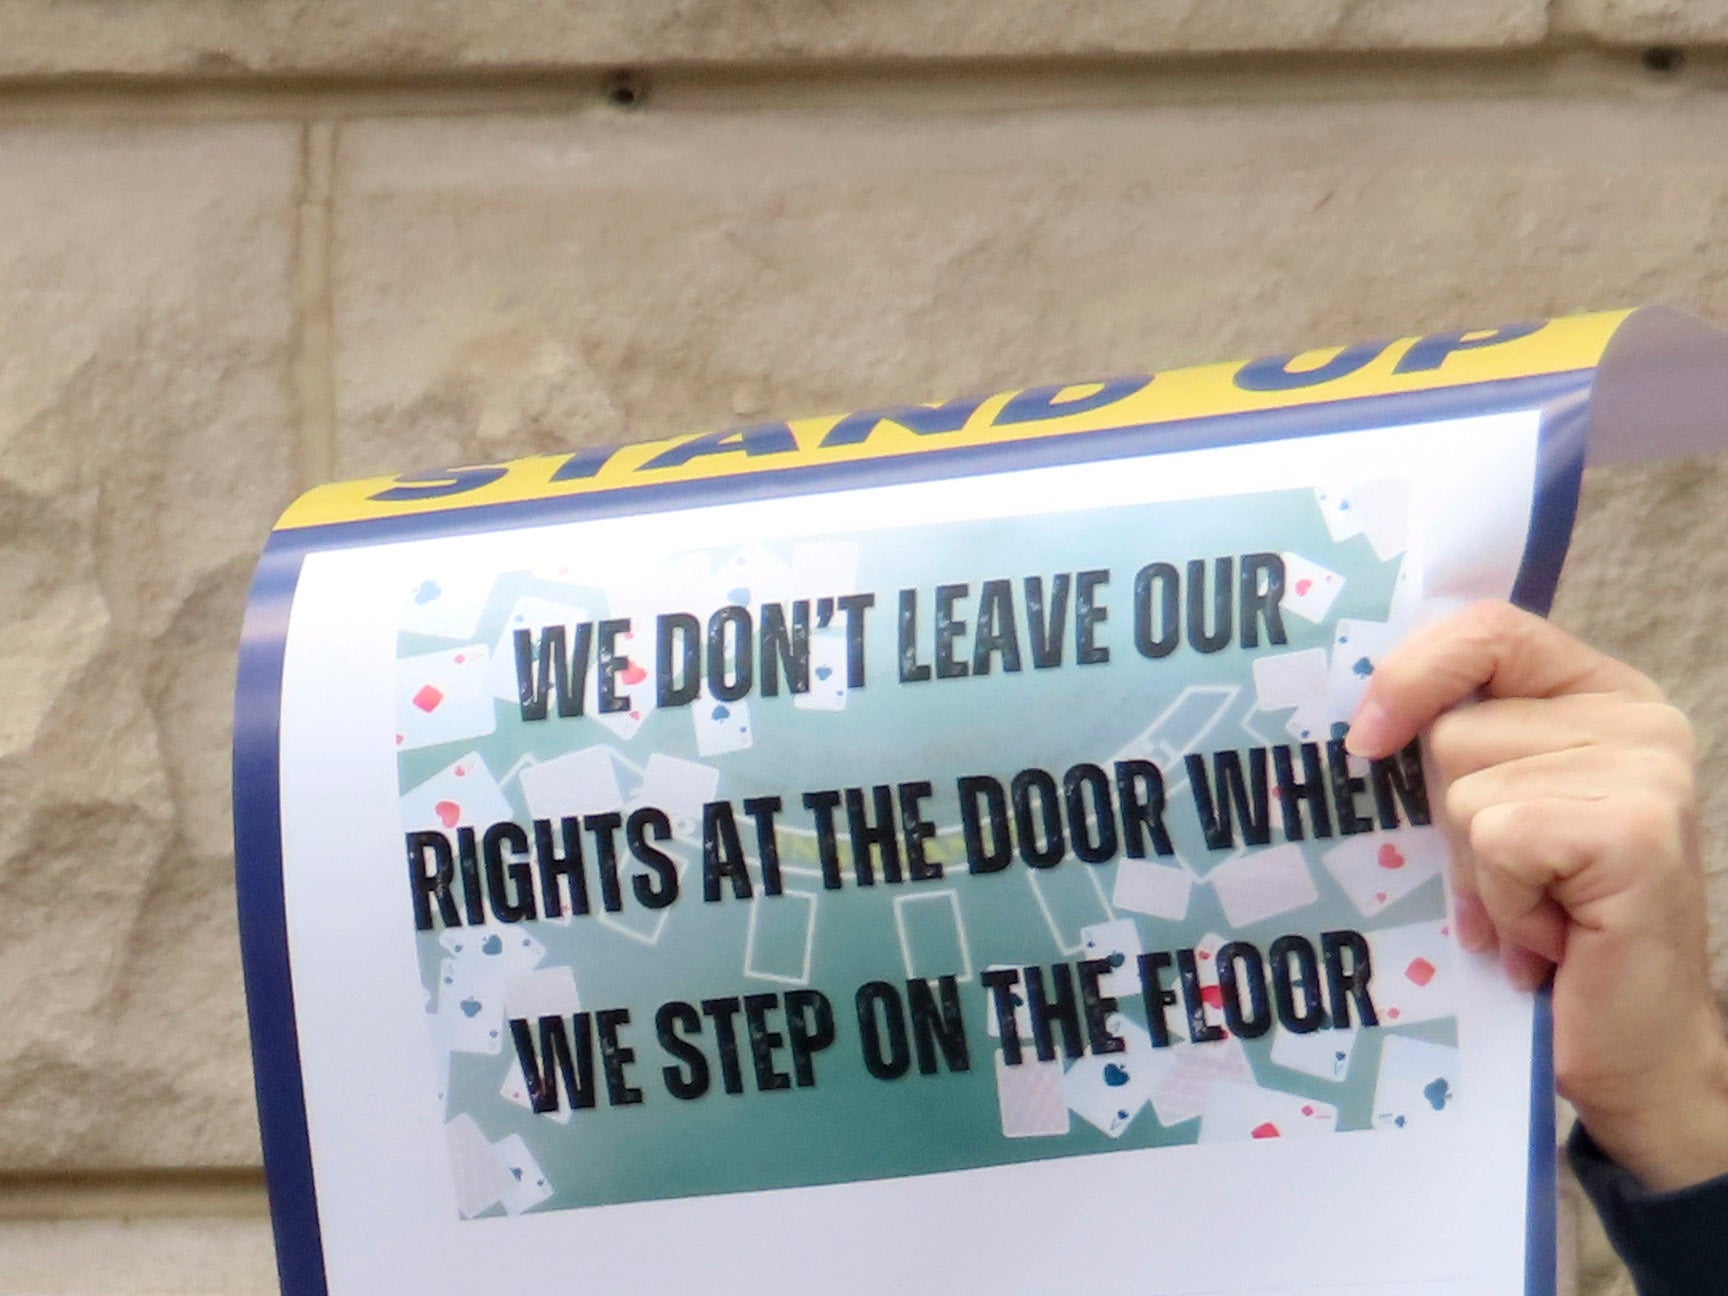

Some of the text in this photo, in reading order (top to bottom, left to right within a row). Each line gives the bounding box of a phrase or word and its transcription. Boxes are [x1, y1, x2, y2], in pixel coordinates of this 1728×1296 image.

[512, 618, 635, 723] WE
[895, 568, 1111, 684] LEAVE
[1132, 550, 1289, 661] OUR
[404, 735, 1433, 932] RIGHTS AT THE DOOR WHEN
[509, 929, 1380, 1114] WE STEP ON THE FLOOR
